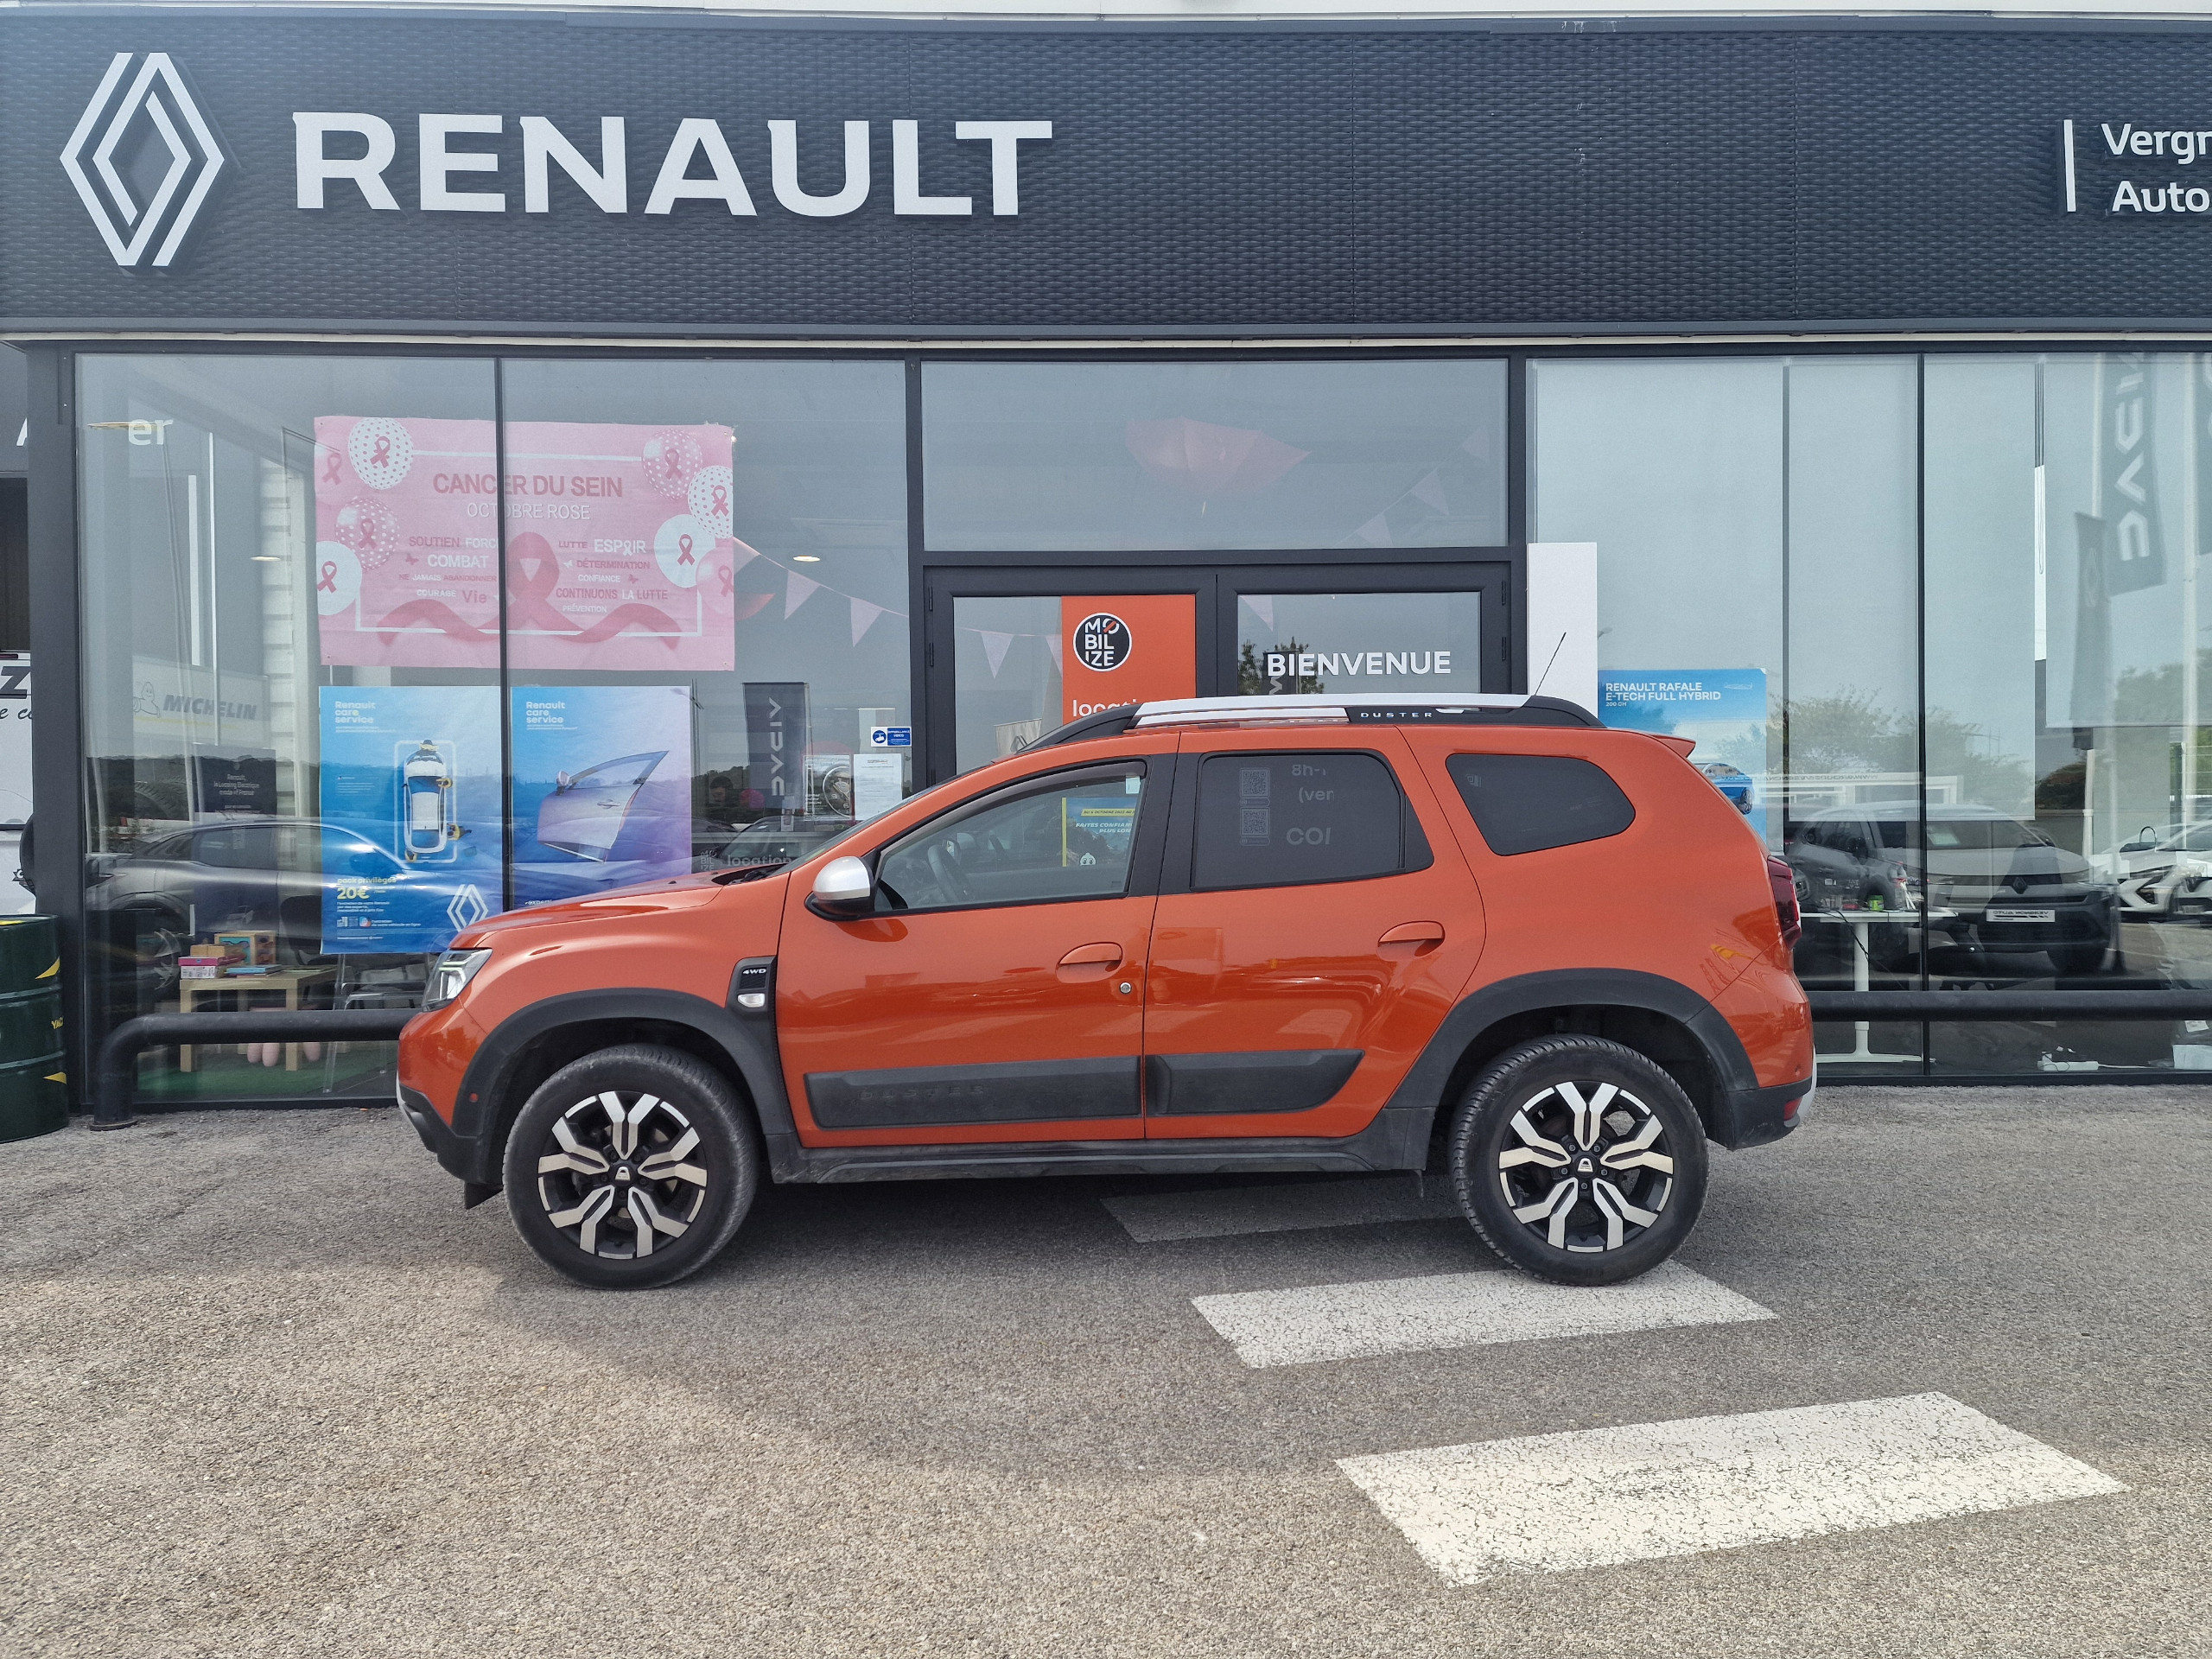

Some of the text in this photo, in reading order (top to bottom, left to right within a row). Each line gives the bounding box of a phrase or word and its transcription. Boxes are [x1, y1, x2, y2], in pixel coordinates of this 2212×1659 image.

[292, 111, 1052, 218] RENAULT
[433, 473, 623, 497] CANCER DU SEIN
[548, 504, 590, 519] ROSE
[409, 536, 499, 549] SOUTIEN FORC
[558, 540, 588, 549] LUTTE
[427, 554, 489, 569] COMBAT
[576, 557, 651, 569] DÉTERMINATION
[412, 574, 442, 582] JAMAIS
[577, 574, 621, 583] CONFIANCE
[416, 588, 488, 604] COURAGE Vie
[556, 588, 669, 601] CONTINUONS LA LUTTE
[1267, 651, 1452, 677] BIENVENUE
[1605, 682, 1702, 692] RENAULT RAFALE
[1605, 691, 1721, 701] E-TECH FULL HYBRID
[162, 694, 257, 721] MICHELIN
[334, 700, 377, 709] Renault
[525, 701, 566, 709] Renault
[336, 886, 370, 899] 20€
